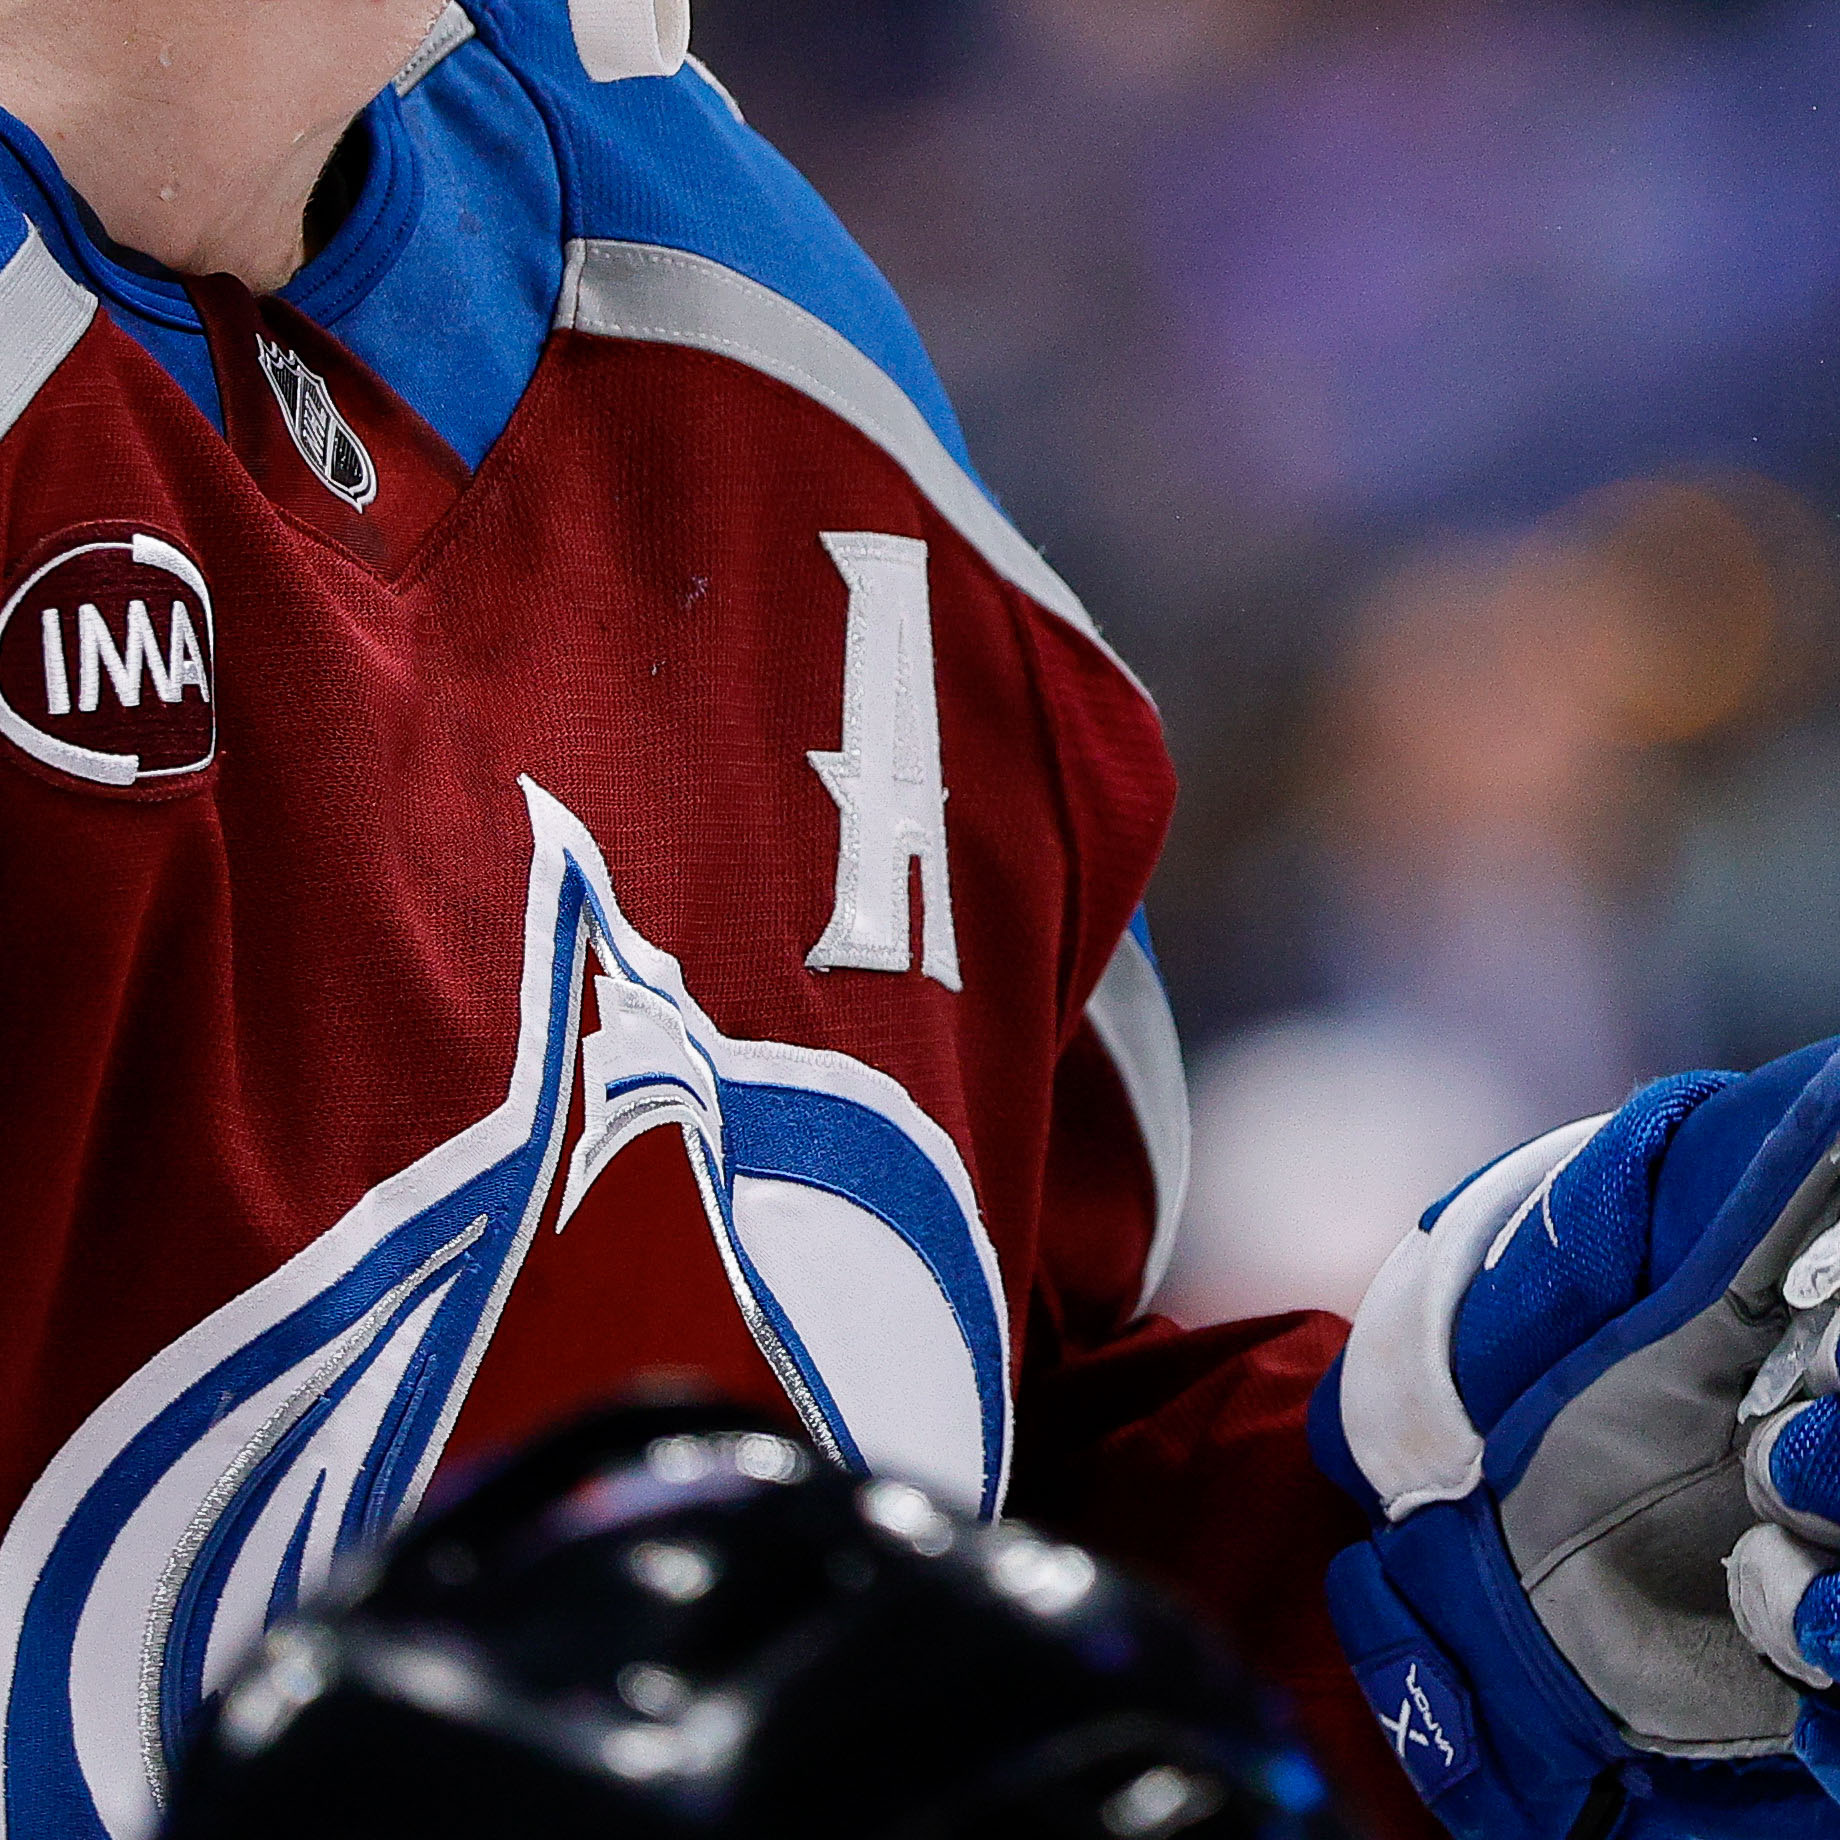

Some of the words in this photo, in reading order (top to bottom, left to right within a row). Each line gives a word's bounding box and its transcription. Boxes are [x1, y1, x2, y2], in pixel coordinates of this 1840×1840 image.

[41, 599, 211, 715] IMA
[804, 530, 963, 993] A
[1405, 1662, 1455, 1768] VAPOR
